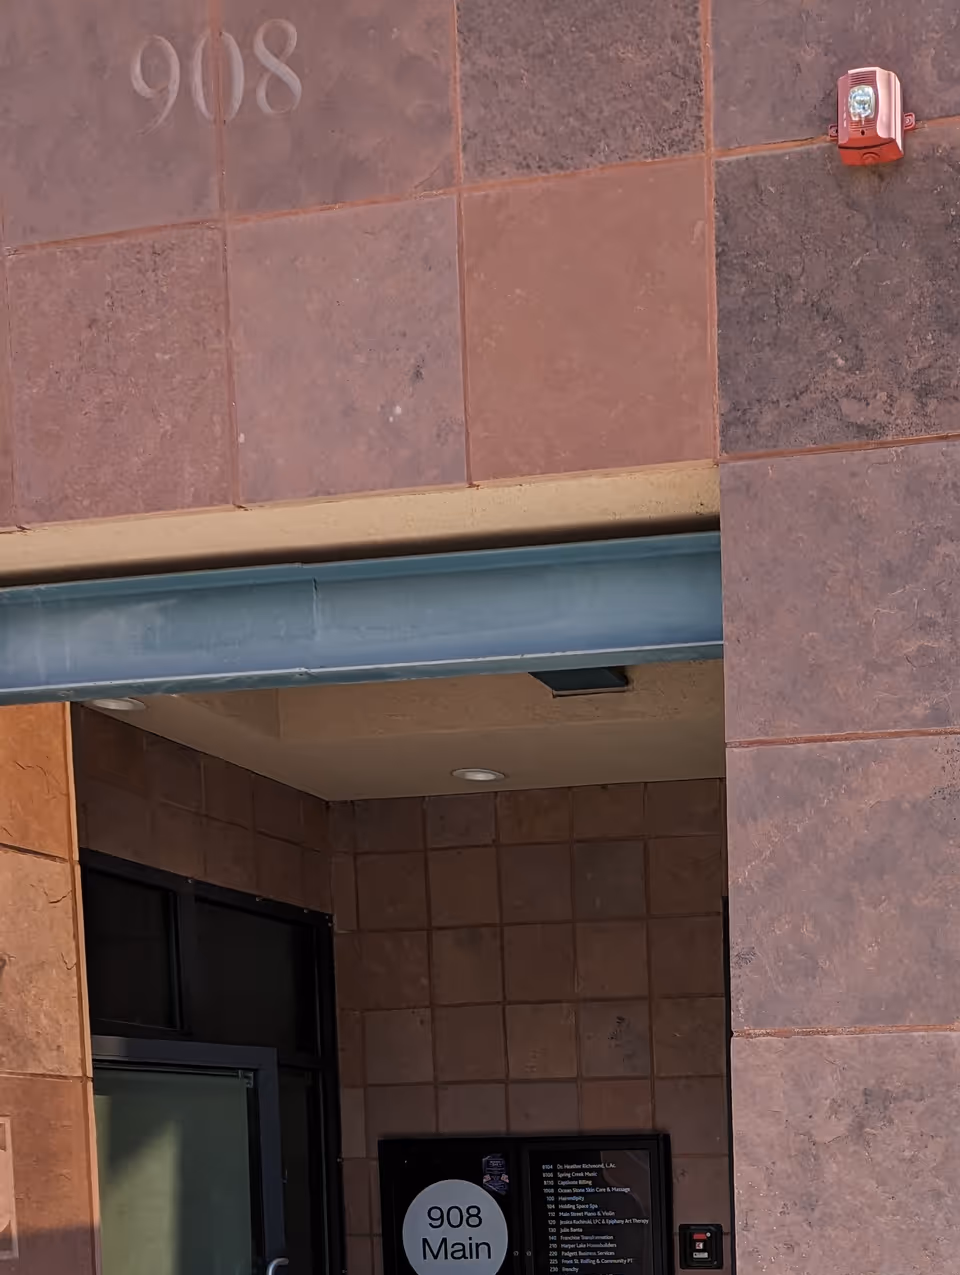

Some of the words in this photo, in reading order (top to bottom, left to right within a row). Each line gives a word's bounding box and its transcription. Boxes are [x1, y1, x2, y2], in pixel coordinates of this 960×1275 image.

[130, 18, 302, 136] 908
[557, 1171, 571, 1179] Spring
[611, 1186, 631, 1194] Massage
[427, 1204, 483, 1229] 908
[632, 1217, 649, 1225] Therapy
[421, 1236, 492, 1261] Main
